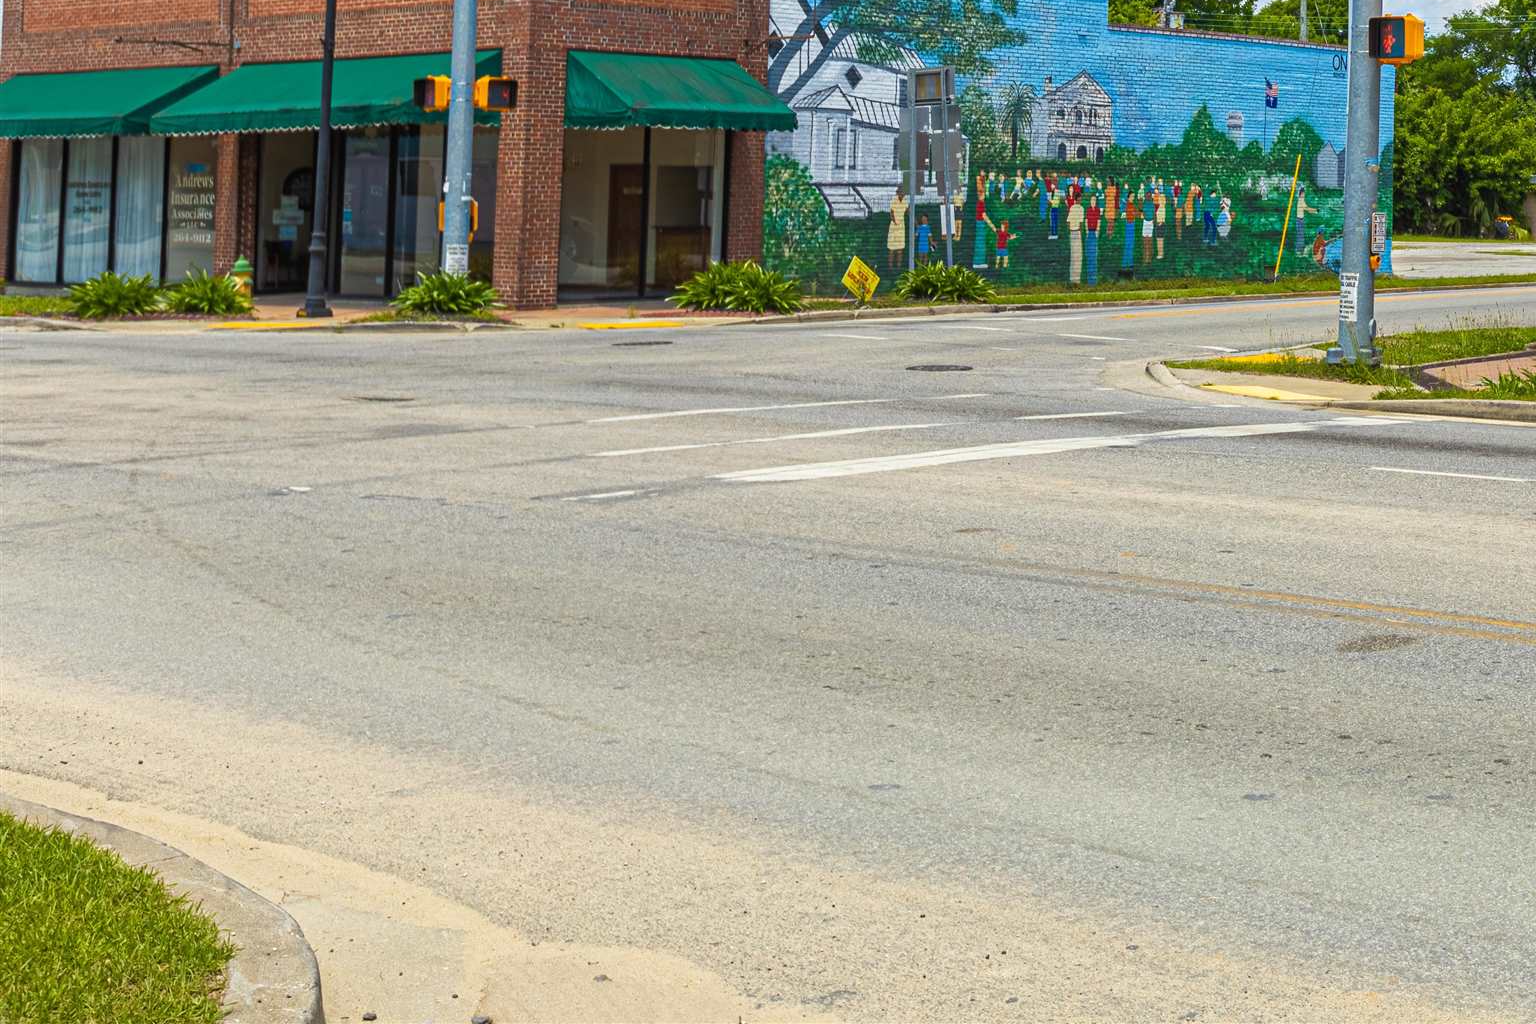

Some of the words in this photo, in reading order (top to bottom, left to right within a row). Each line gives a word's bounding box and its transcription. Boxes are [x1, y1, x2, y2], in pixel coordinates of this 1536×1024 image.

[175, 174, 214, 188] Andrews
[171, 191, 216, 206] Insurance
[172, 208, 213, 220] Associates
